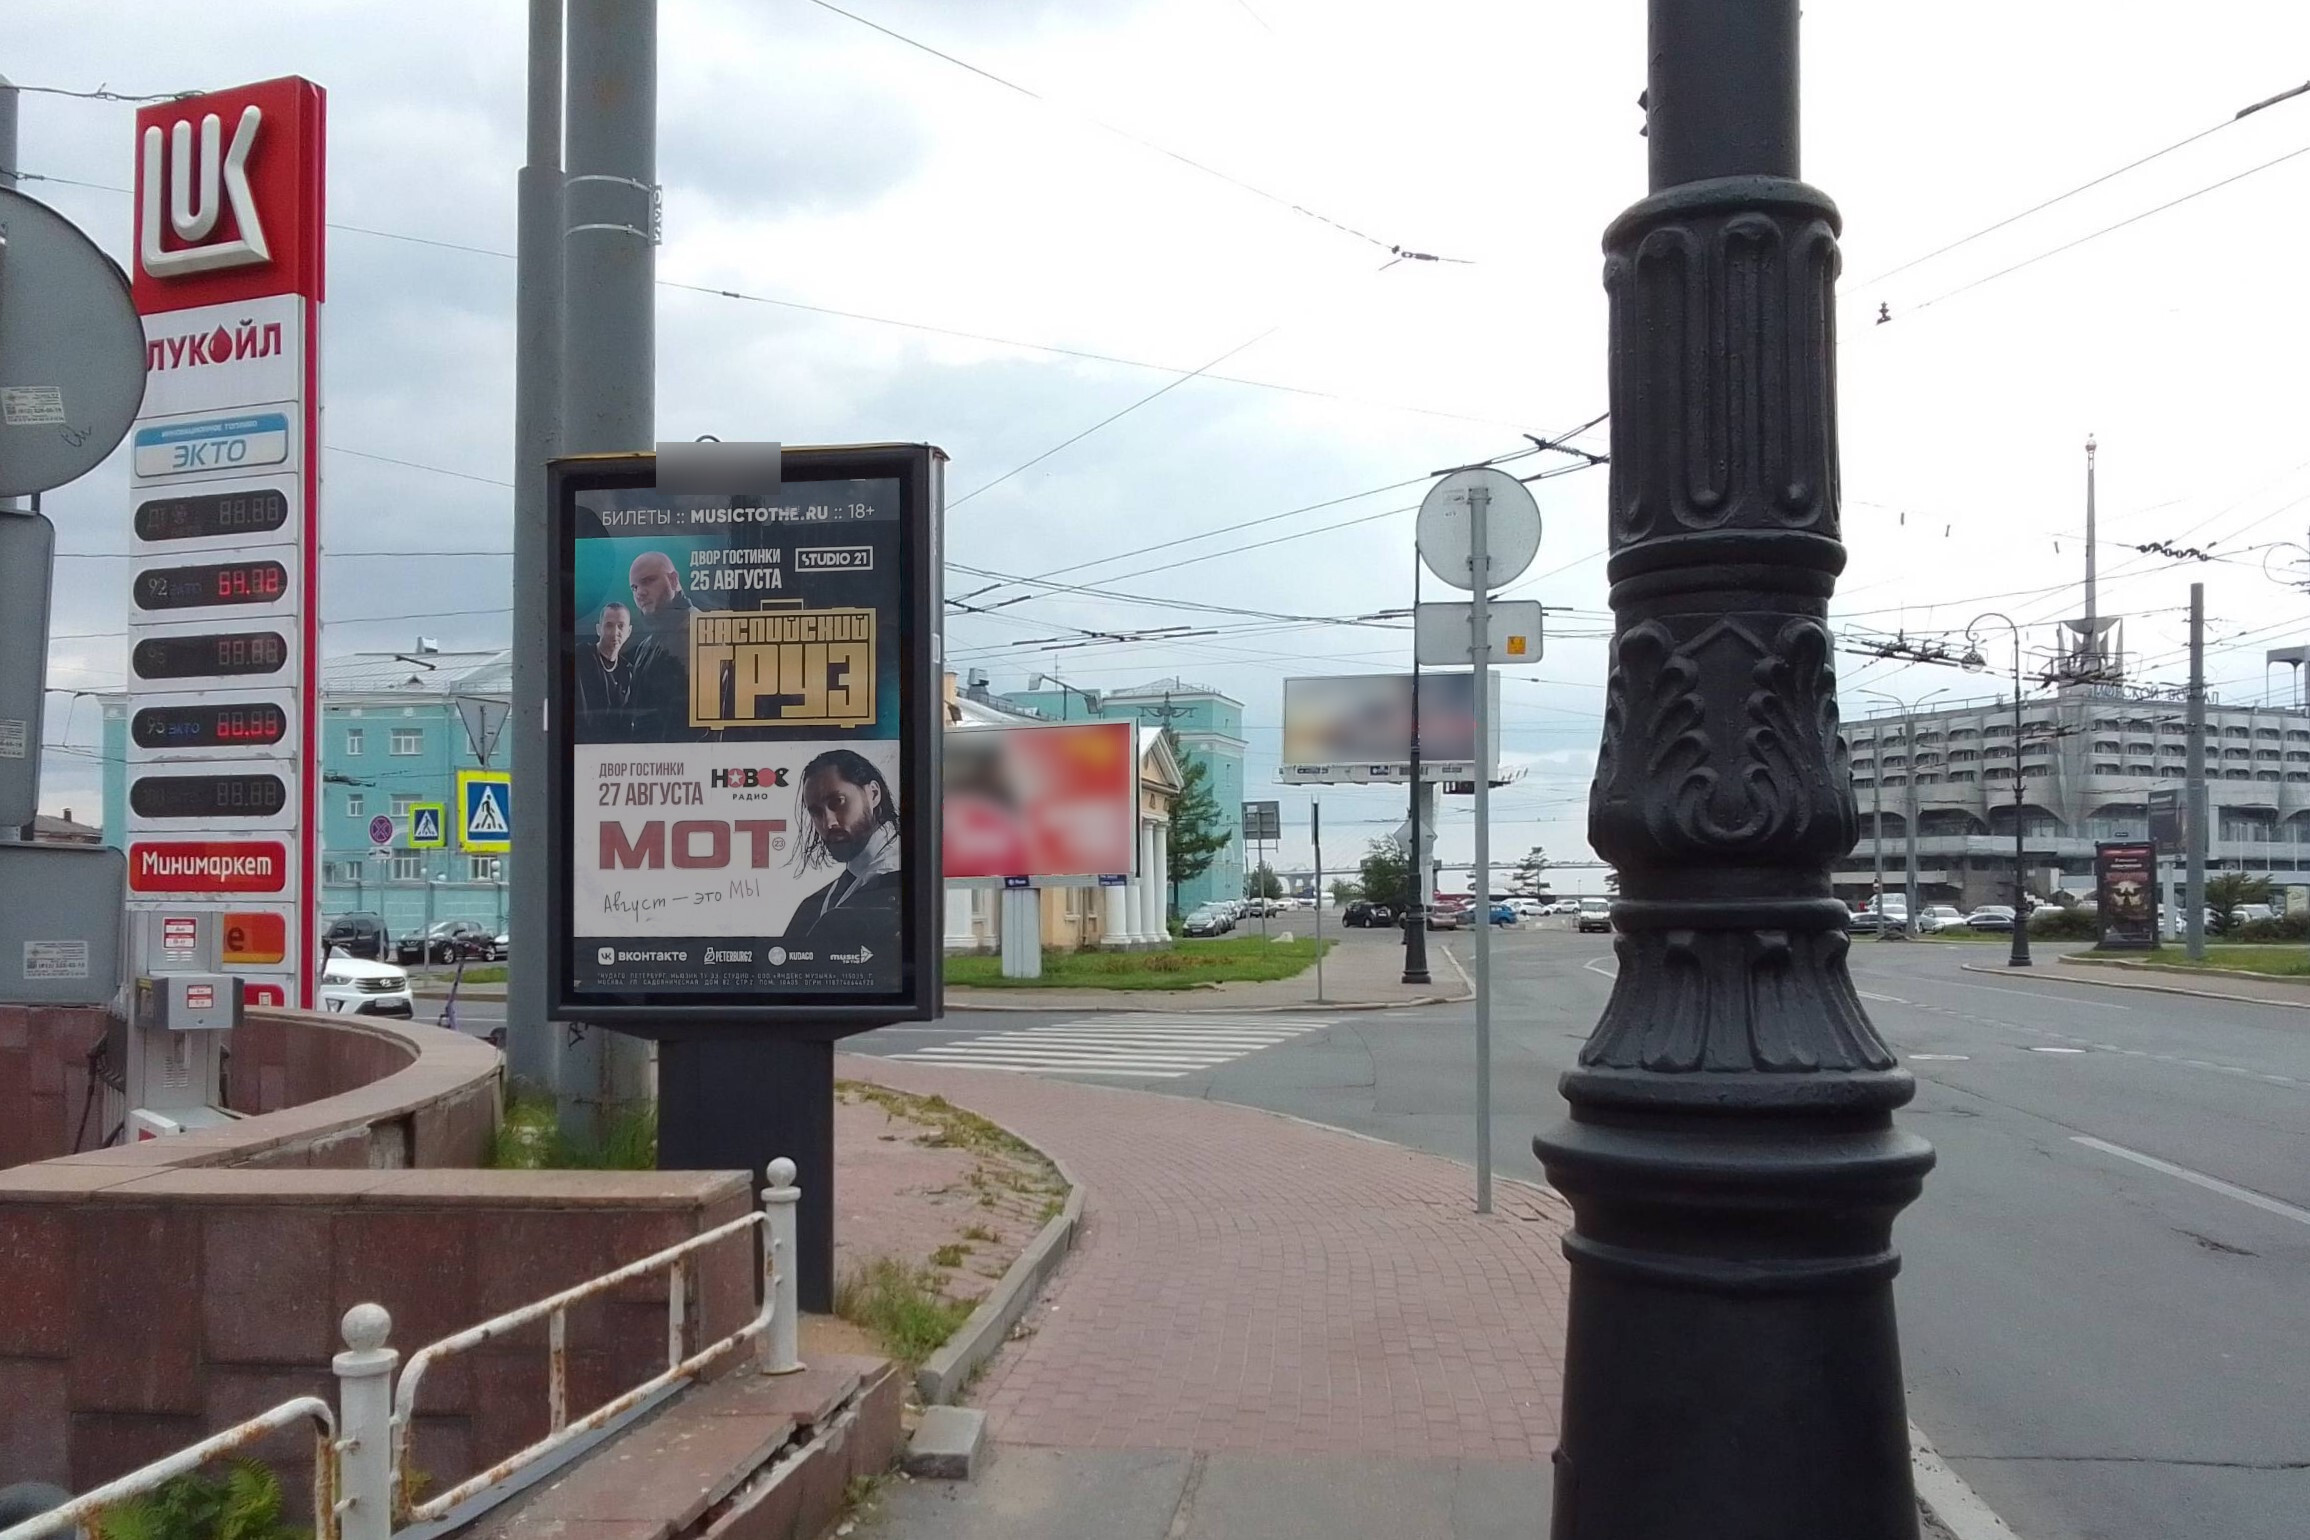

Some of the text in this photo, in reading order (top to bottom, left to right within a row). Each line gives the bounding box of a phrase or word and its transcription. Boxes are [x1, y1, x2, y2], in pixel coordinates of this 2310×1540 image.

[173, 439, 246, 468] ЭКТО
[602, 510, 671, 526] БИЛЕТЫ
[690, 506, 828, 524] MUSICTOTHE.RU
[848, 503, 875, 519] 18+
[690, 548, 781, 567] ДВОР ГОСТИНКИ
[801, 551, 867, 567] STUDIO 21
[690, 568, 783, 591] 25 АВГУСТА
[698, 615, 869, 644] КАСПИЙСКИЙ
[698, 642, 869, 719] ГРУЗ
[599, 762, 684, 778] ДВОР ГОСТИНКИ
[599, 781, 704, 806] 27 АВГУСТА
[732, 793, 768, 802] РАДИО
[599, 820, 787, 870] МОТ
[142, 851, 273, 882] Минимаркет
[604, 891, 666, 922] Август
[693, 891, 722, 905] это
[729, 878, 760, 899] МЫ
